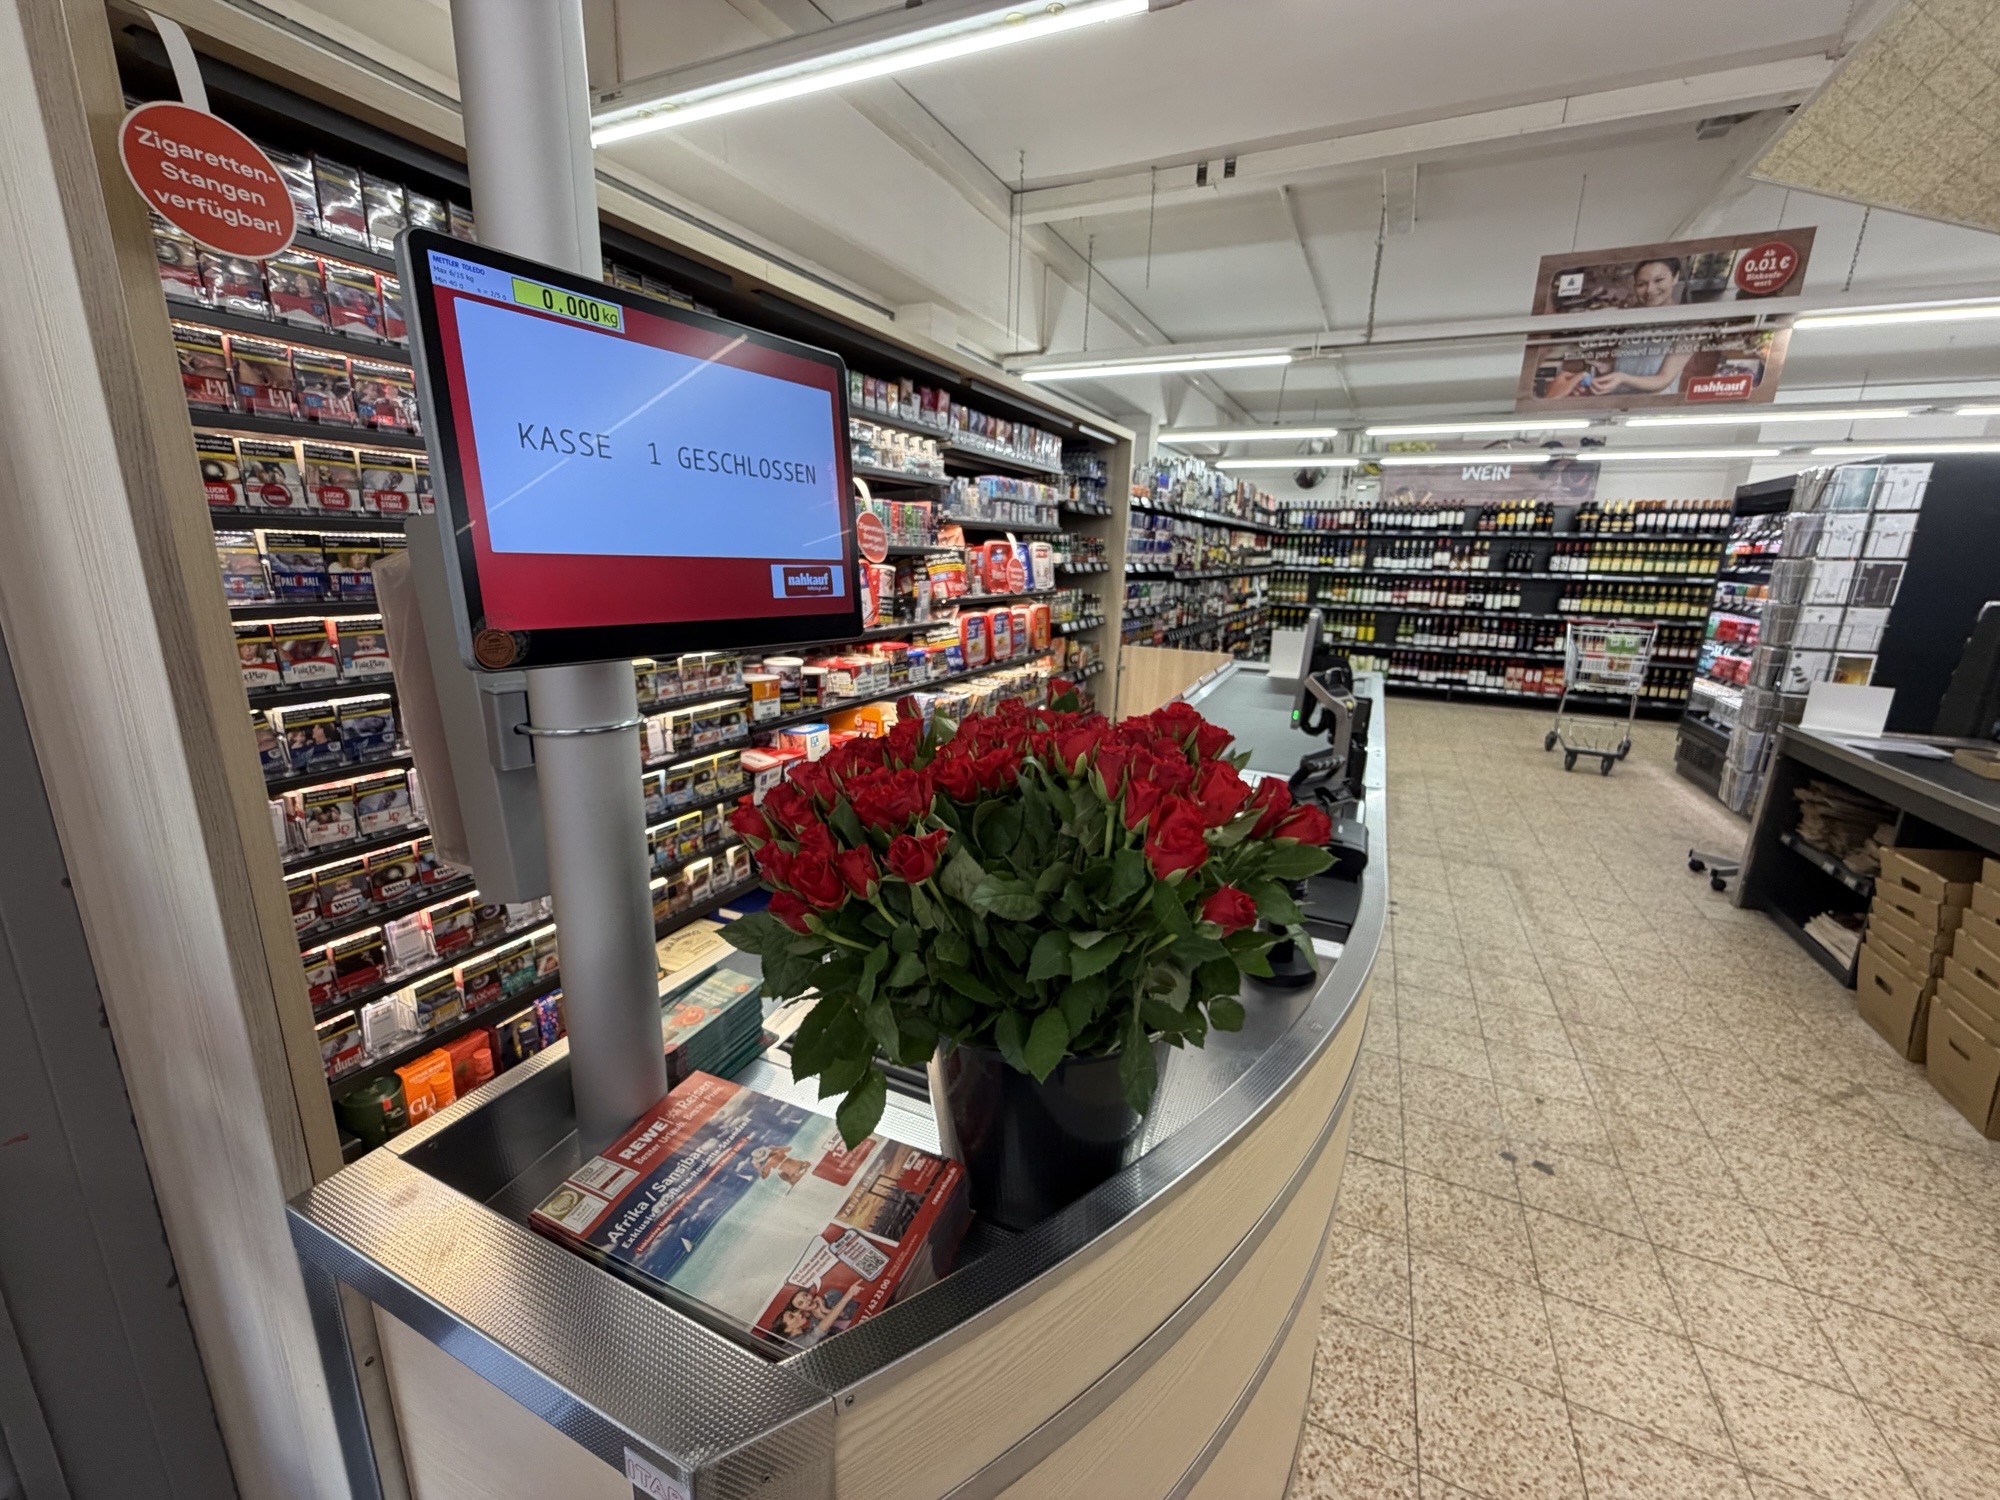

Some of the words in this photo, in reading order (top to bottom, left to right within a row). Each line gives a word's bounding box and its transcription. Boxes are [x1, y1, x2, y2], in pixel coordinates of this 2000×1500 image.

[134, 125, 277, 185] Zigaretten-
[160, 161, 266, 208] Stangen
[153, 187, 283, 237] verfügbar!
[432, 254, 460, 269] METTLER
[461, 262, 486, 276] TOLEDO
[1744, 257, 1777, 273] 0.01
[1779, 255, 1792, 269] €
[433, 266, 448, 276] Max
[448, 269, 464, 279] 6/15
[542, 289, 600, 322] 0.000
[602, 308, 618, 328] kg
[1692, 379, 1747, 393] nahkauf
[518, 422, 612, 460] KASSE
[648, 441, 662, 466] 1
[677, 447, 817, 485] GESCHLOSSEN
[1461, 465, 1511, 481] WEIN
[323, 491, 345, 499] LUCKY
[380, 494, 402, 502] LUCKY
[380, 501, 403, 509] STRIKE
[281, 576, 296, 587] PALL
[302, 576, 320, 586] MALL
[788, 572, 829, 586] nahkauf
[384, 881, 410, 893] West
[332, 896, 361, 910] West
[294, 912, 313, 924] est
[618, 1120, 669, 1161] REWE
[677, 1080, 715, 1110] Reisen
[633, 1144, 660, 1165] Bester
[683, 1100, 708, 1121] Bester
[607, 1200, 649, 1244] Afrika
[652, 1148, 704, 1193] Sansibar
[621, 1204, 659, 1249] Exklusive
[880, 1278, 891, 1291] 00
[873, 1289, 885, 1301] 23
[868, 1300, 880, 1311] 42
